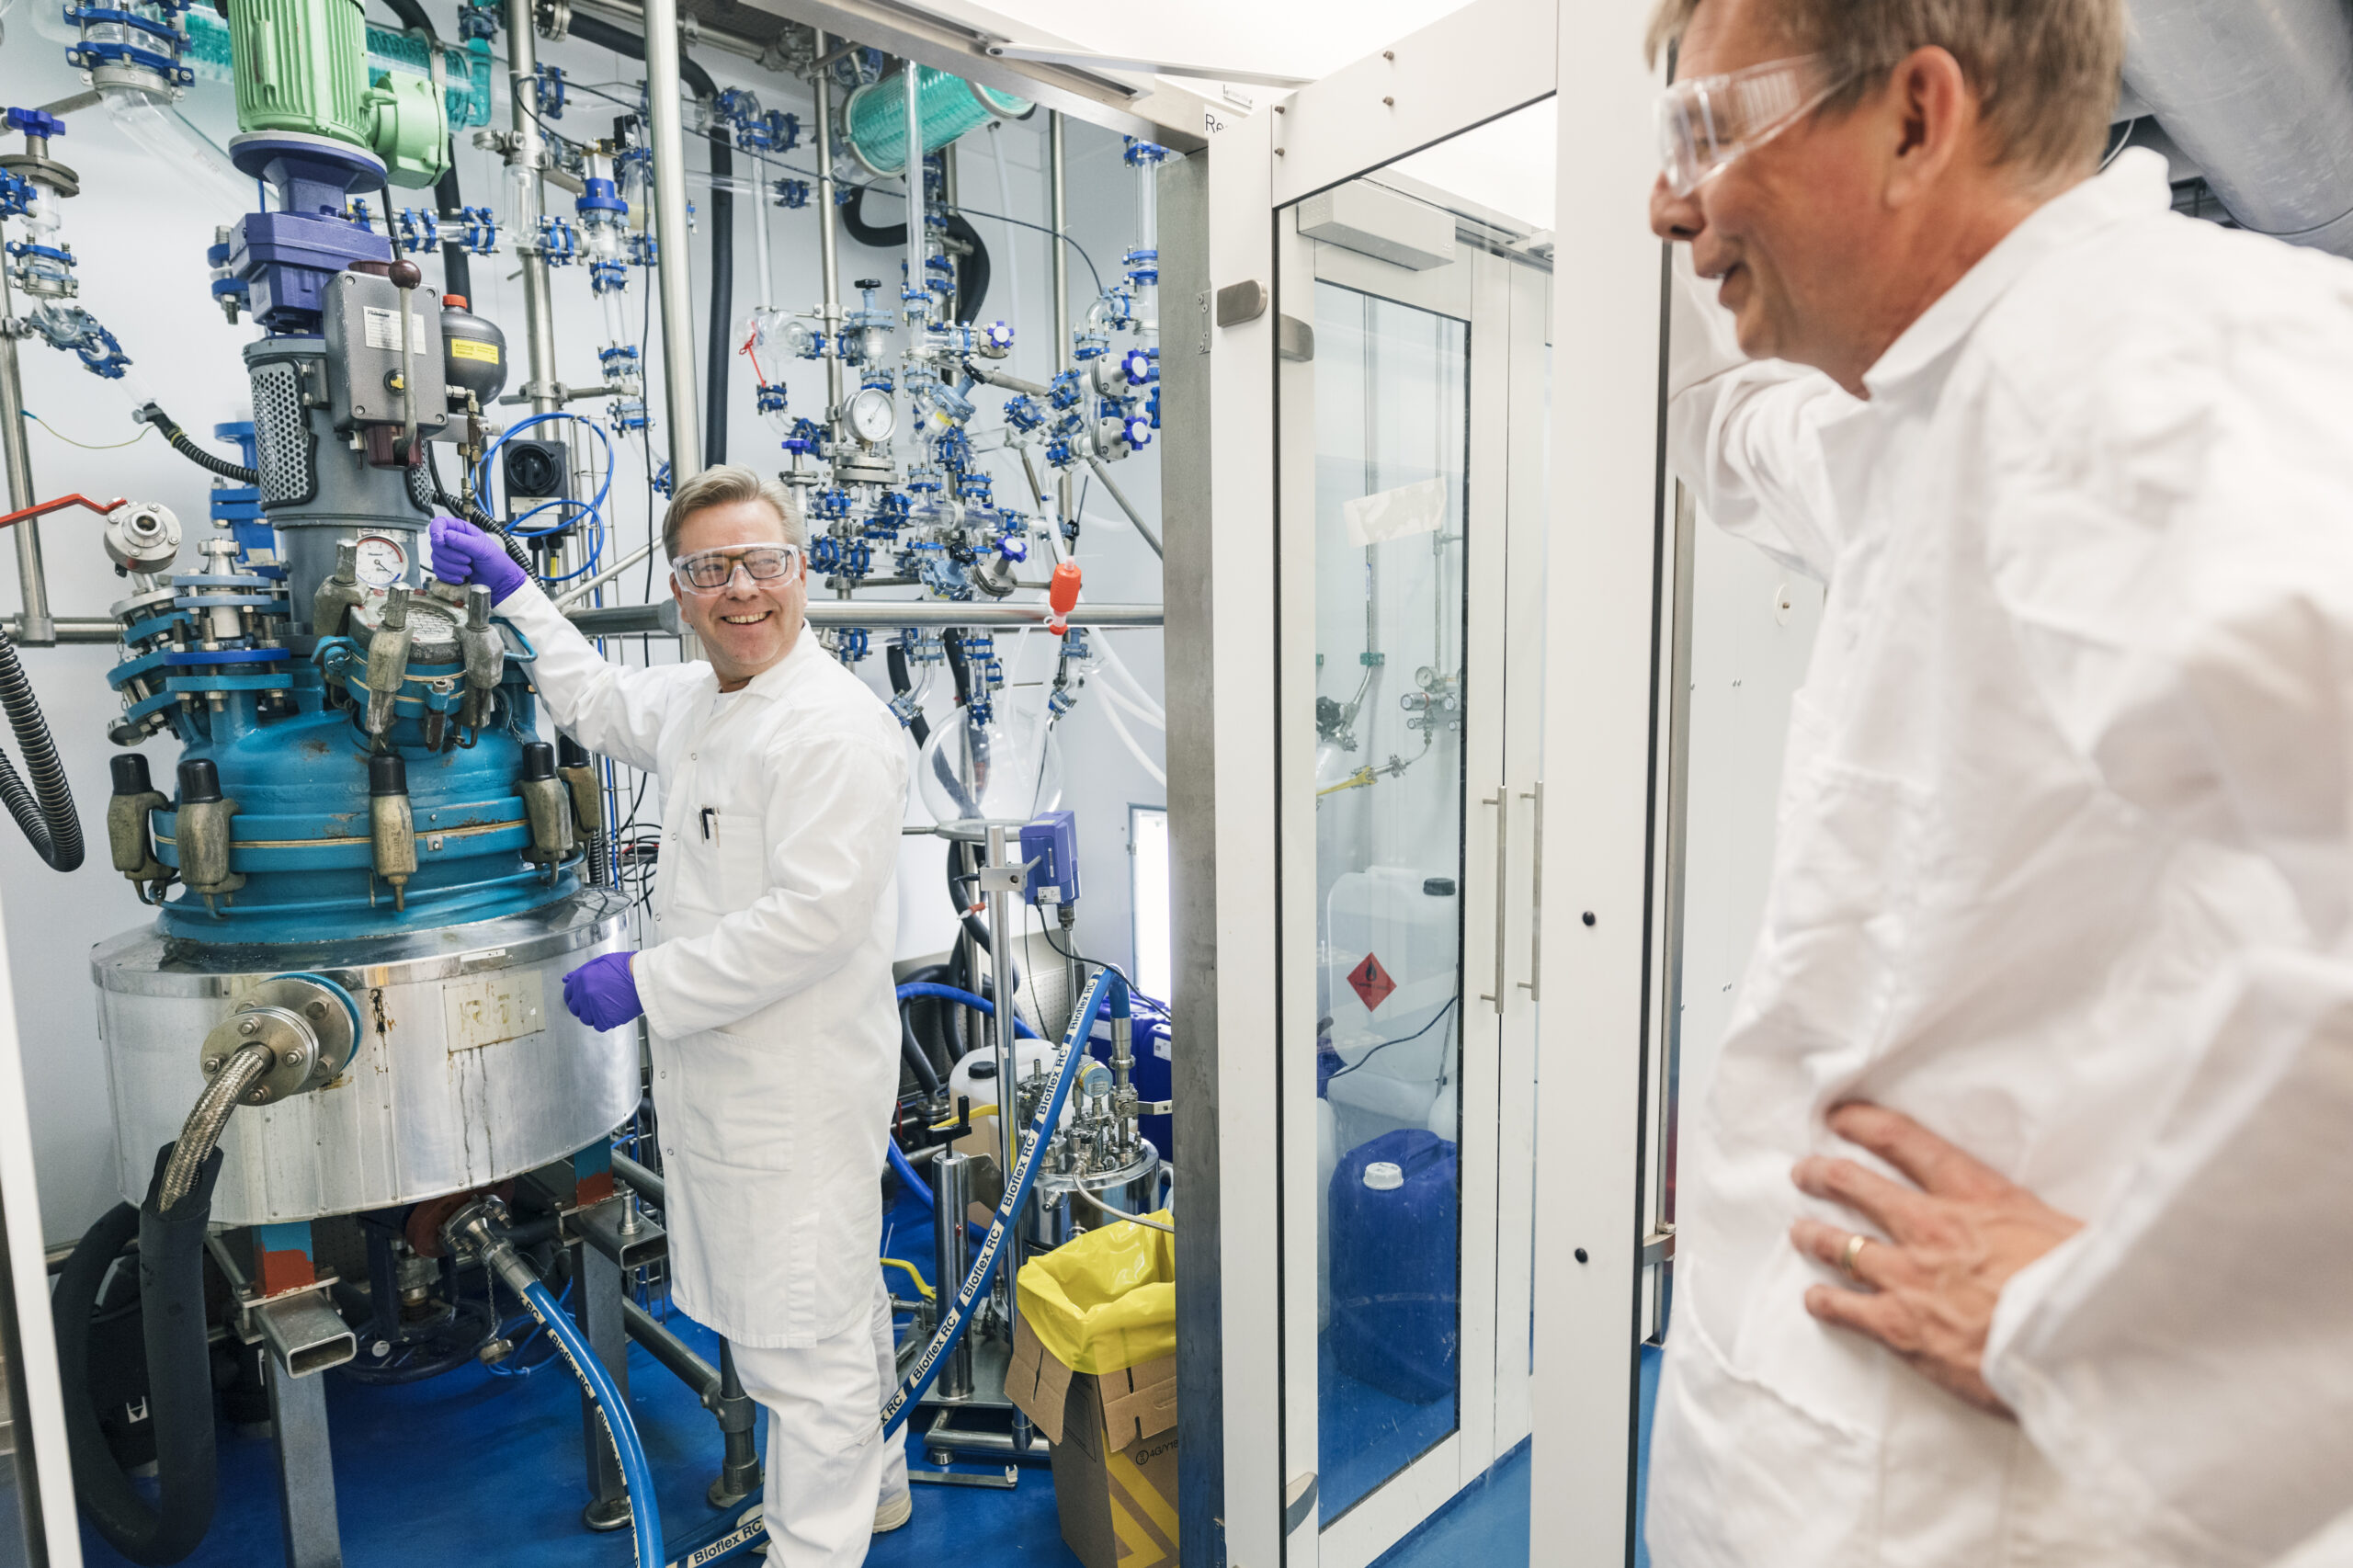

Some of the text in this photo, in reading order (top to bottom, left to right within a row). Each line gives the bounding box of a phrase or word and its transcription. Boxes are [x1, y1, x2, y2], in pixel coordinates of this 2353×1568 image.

[1205, 113, 1227, 133] Re
[1038, 1049, 1068, 1115] Bioflex RC
[1003, 1137, 1036, 1208] Bioflex RC
[962, 1228, 1001, 1298] Bioflex RC
[913, 1315, 957, 1381] Bioflex RC
[886, 1394, 903, 1415] RC
[693, 1520, 763, 1564] Bioflex RC
